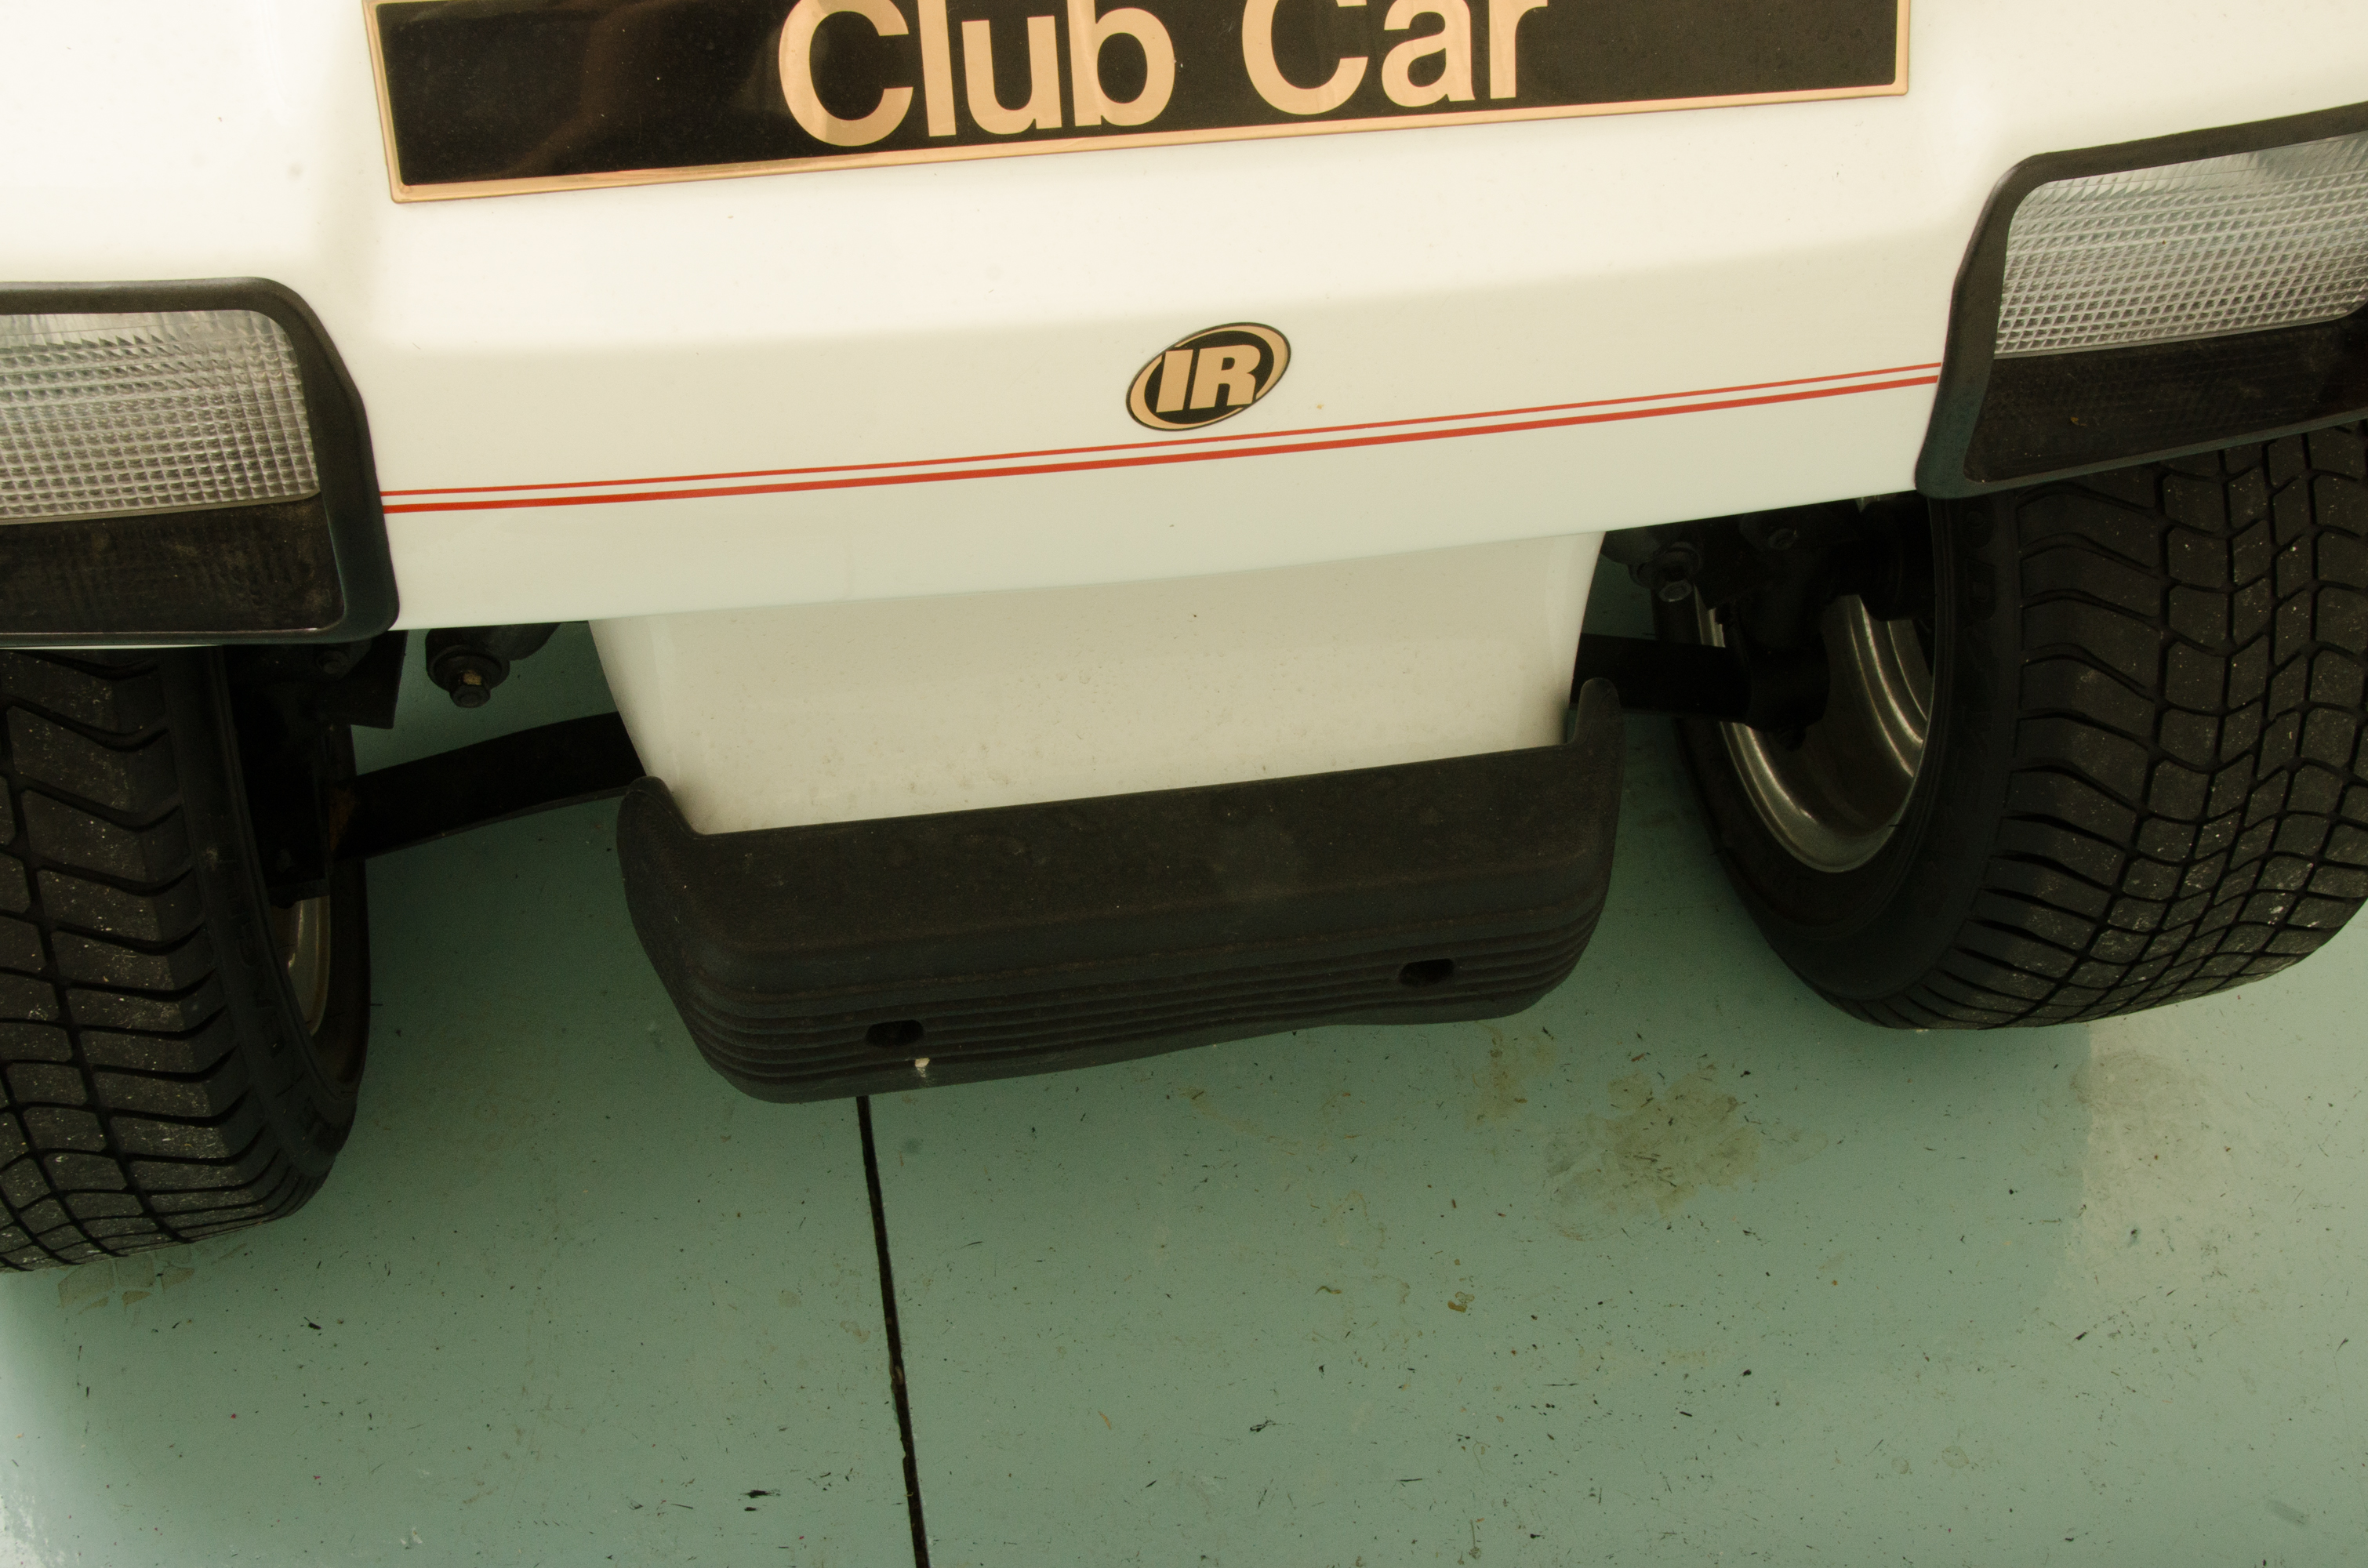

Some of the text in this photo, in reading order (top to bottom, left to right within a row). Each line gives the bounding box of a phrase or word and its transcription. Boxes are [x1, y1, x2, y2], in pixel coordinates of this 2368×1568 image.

[779, 0, 1549, 147] Club Car
[1155, 343, 1261, 413] IR
